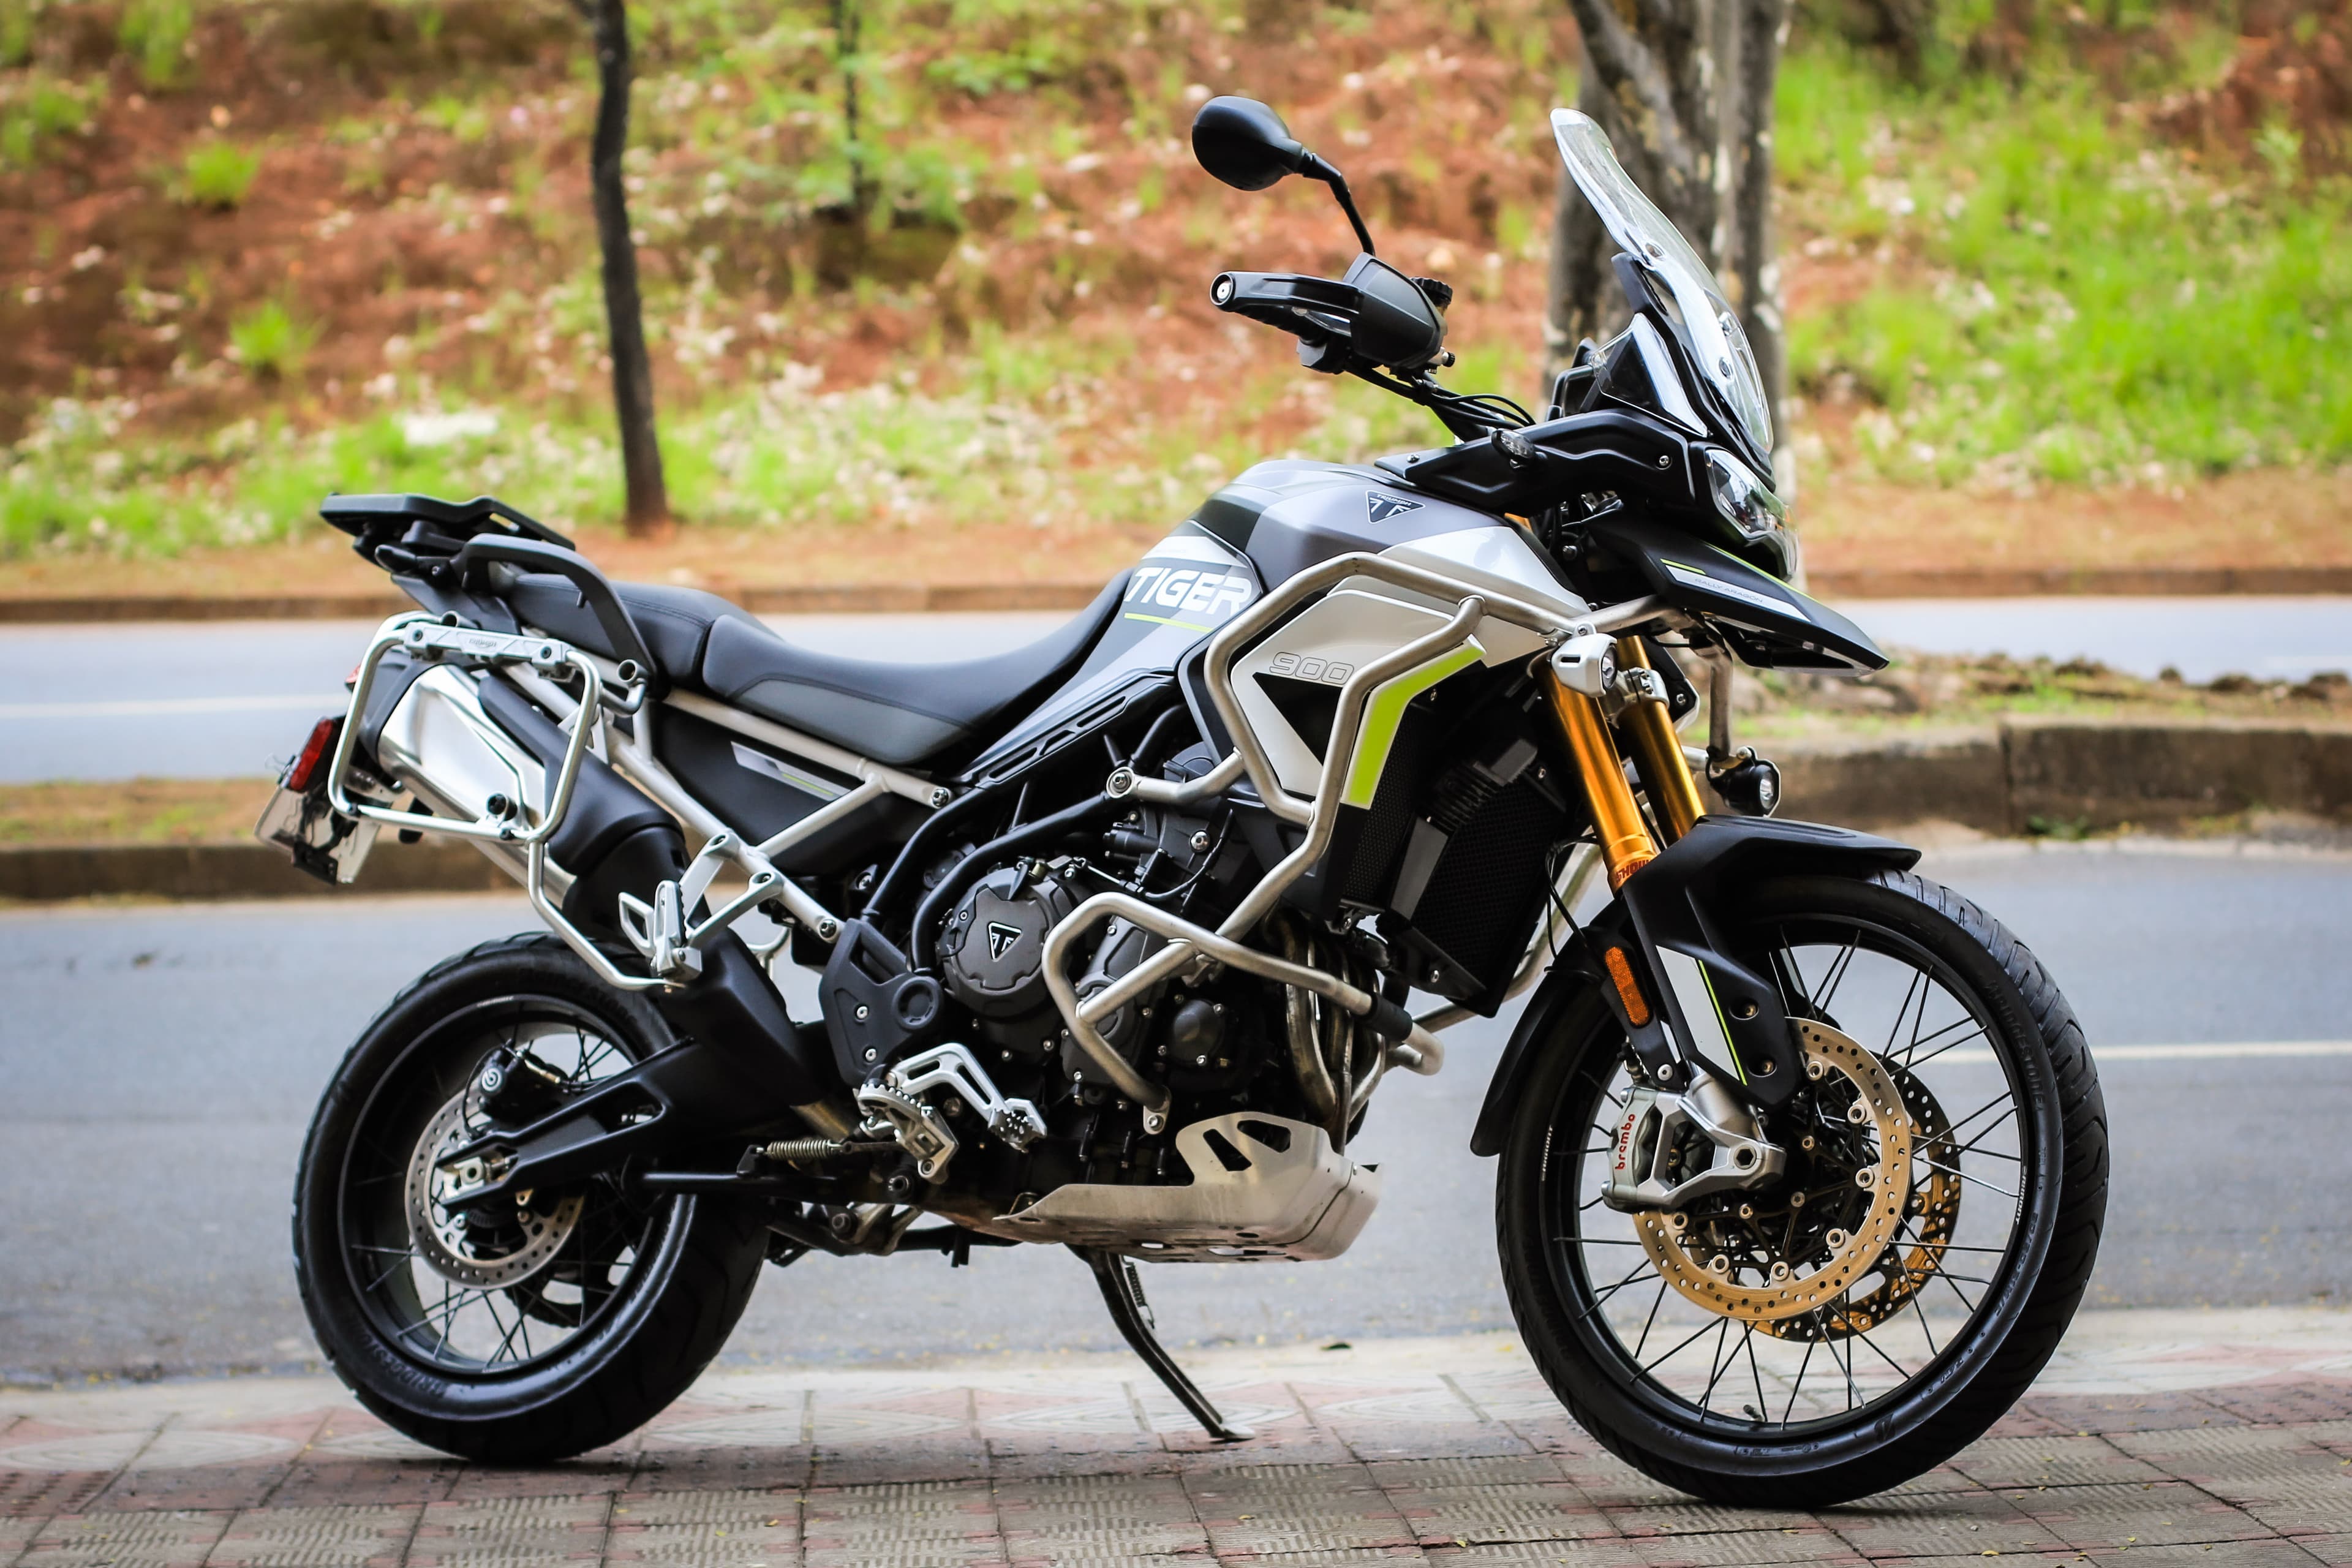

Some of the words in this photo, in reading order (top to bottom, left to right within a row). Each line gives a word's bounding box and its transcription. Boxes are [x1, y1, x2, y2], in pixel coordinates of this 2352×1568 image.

[1376, 494, 1412, 506] TRIUMPH
[1125, 567, 1252, 616] TIGER
[1695, 578, 1723, 589] RALLY
[1269, 652, 1354, 685] 900
[1615, 1114, 1636, 1170] brembo
